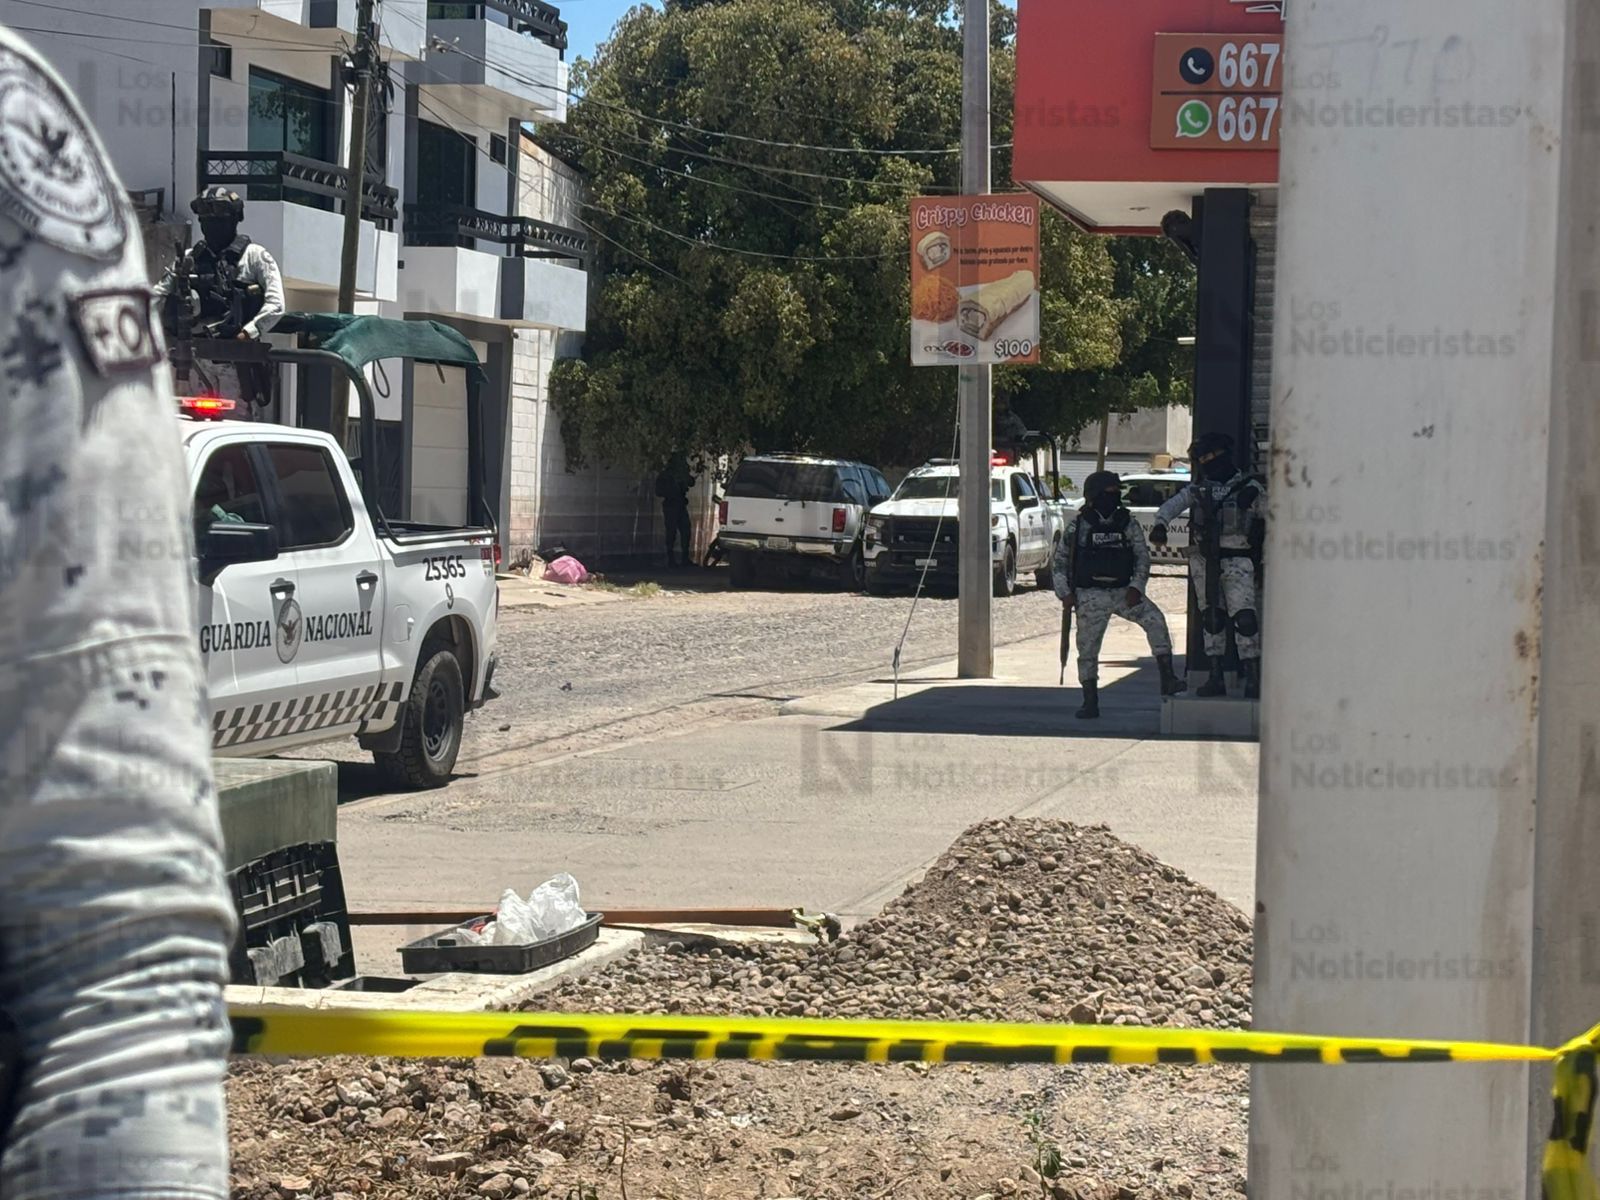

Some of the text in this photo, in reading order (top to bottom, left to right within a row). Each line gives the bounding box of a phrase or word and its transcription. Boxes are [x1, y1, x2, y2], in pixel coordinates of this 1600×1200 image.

[1219, 43, 1284, 87] 667
[1217, 97, 1282, 142] 667
[916, 202, 1034, 230] Crispy Chicken
[994, 339, 1032, 358] $100
[422, 554, 466, 581] 25365
[200, 610, 373, 653] GUARDIA NACIONAL
